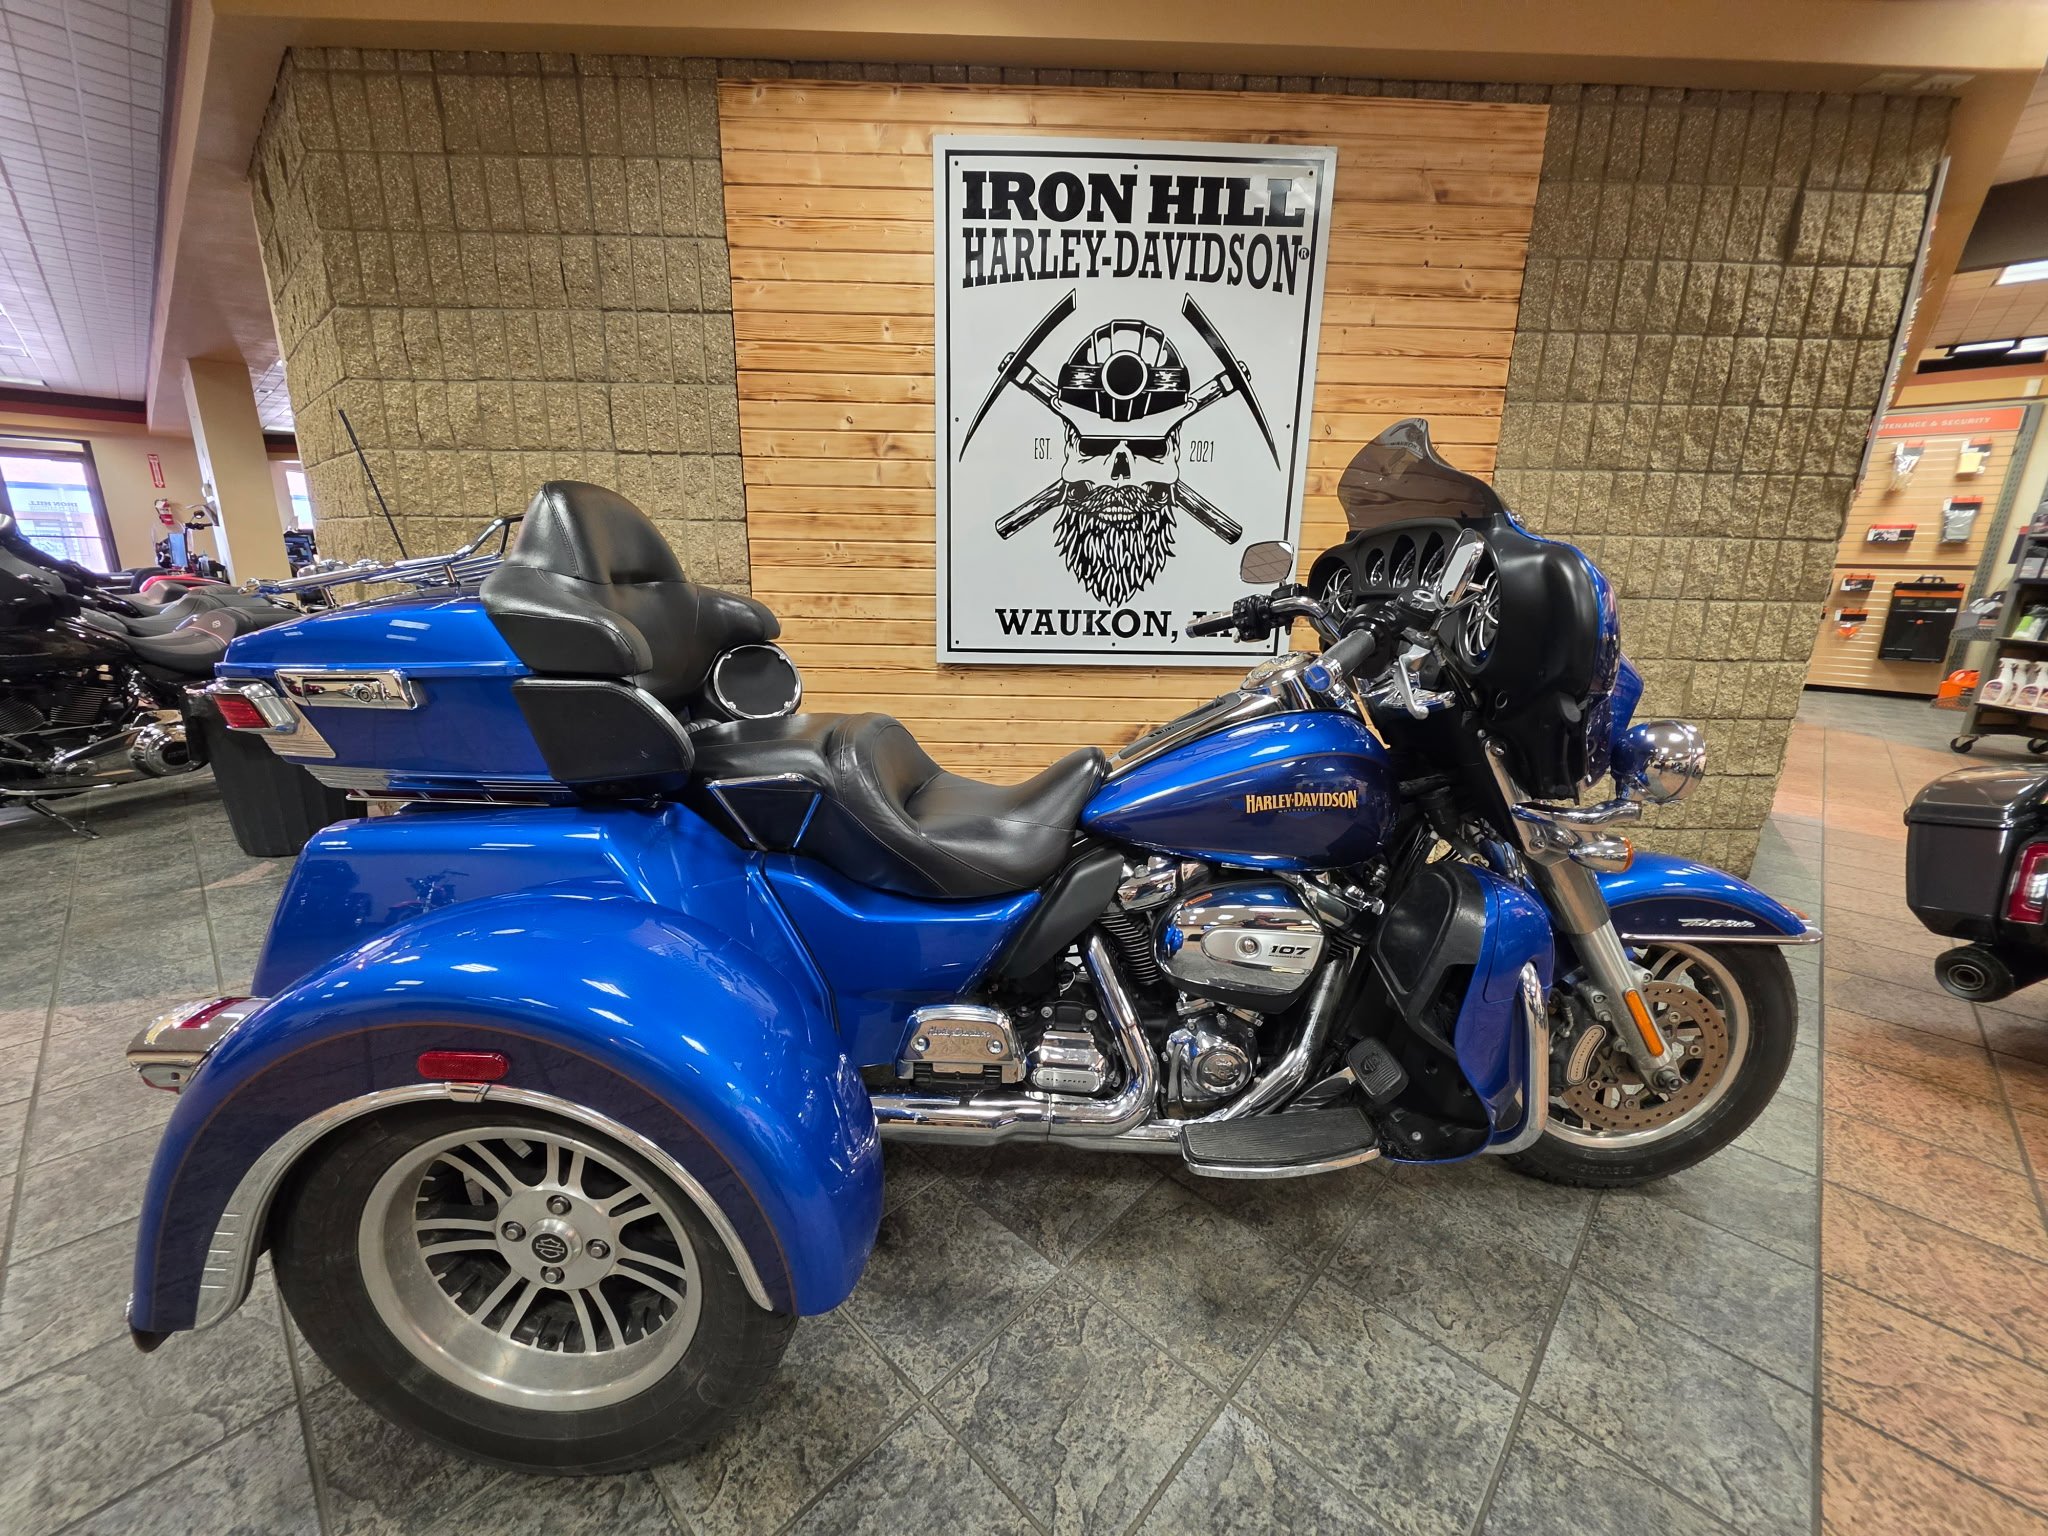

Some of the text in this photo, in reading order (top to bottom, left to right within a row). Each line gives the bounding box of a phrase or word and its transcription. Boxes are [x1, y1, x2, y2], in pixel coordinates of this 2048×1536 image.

[962, 171, 1306, 228] IRON HILL
[1877, 420, 1926, 431] NTENANCE
[1941, 416, 1992, 428] SECURITY
[1034, 438, 1215, 463] EST. 2021
[995, 608, 1178, 643] WAUKON,
[1271, 945, 1311, 955] 107
